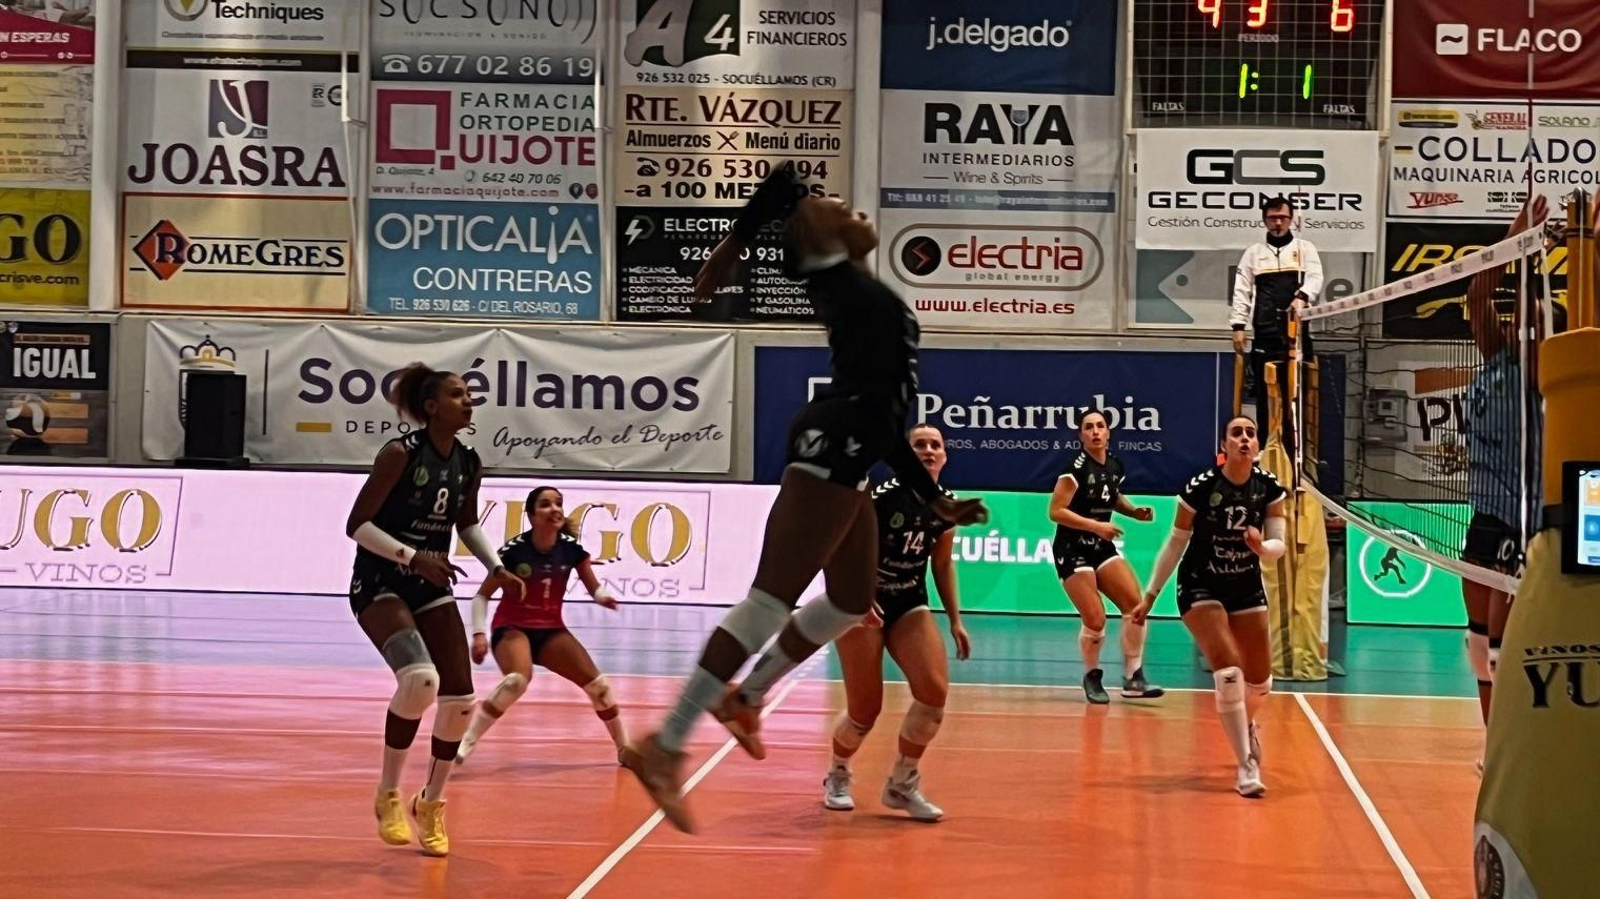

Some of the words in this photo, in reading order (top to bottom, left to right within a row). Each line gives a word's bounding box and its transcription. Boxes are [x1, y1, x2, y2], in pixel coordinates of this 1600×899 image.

[214, 1, 324, 24] Techniques
[758, 11, 836, 25] SERVICIOS
[747, 31, 848, 47] FINANCIEROS
[926, 17, 1070, 52] j.delgado
[1477, 28, 1583, 52] FLACO
[418, 55, 467, 74] 677
[476, 55, 509, 76] 02
[518, 56, 552, 77] 86
[563, 57, 594, 77] 19
[636, 73, 659, 83] 926
[663, 73, 685, 84] 532
[688, 74, 710, 84] 025
[722, 73, 807, 86] SOCUÉLLAMOS
[812, 76, 836, 87] (CR)
[460, 92, 595, 109] FARMACIA
[625, 94, 688, 122] RTE.
[698, 91, 842, 127] VÁZQUEZ
[1152, 102, 1185, 112] FALTAS
[1323, 104, 1355, 114] FALTAS
[460, 115, 595, 133] ORTOPEDIA
[924, 103, 1075, 146] RAYA
[626, 130, 711, 149] Almuerzos
[745, 132, 789, 150] Menú
[794, 133, 841, 151] diario
[1418, 136, 1597, 164] COLLADO
[128, 143, 346, 187] JOASRA
[664, 158, 712, 178] 926
[723, 160, 770, 179] 530
[923, 153, 1075, 167] INTERMEDIARIOS
[1187, 149, 1326, 185] GCS
[528, 174, 543, 184] 70
[954, 172, 986, 183] Wine
[991, 173, 1000, 184] &
[1003, 172, 1044, 186] Spirits
[1393, 167, 1514, 184] MAQUINARIA
[661, 181, 707, 198] 100
[1148, 216, 1200, 228] Gestión
[1304, 218, 1366, 230] Servicios
[680, 247, 712, 260] 926
[757, 247, 784, 261] 931
[947, 235, 1083, 271] electria
[413, 267, 593, 294] CONTRERAS
[965, 272, 1009, 282] global
[1014, 274, 1061, 284] energy
[413, 298, 430, 311] 926
[491, 301, 512, 313] DEL
[566, 303, 578, 314] 68
[667, 296, 679, 304] DE
[915, 298, 1075, 315] www.electria.es
[13, 347, 97, 379] IGUAL
[298, 357, 700, 412] Socéllamos
[915, 394, 1162, 431] Peñarrubia
[493, 425, 602, 459] Apoyando
[611, 424, 633, 445] el
[639, 424, 724, 452] Deporte
[980, 440, 1048, 450] ABOGADOS
[1053, 440, 1060, 450] &
[1118, 442, 1162, 452] FINCAS
[433, 488, 449, 514] 8
[1101, 484, 1111, 502] 4
[1224, 505, 1248, 530] 12
[902, 531, 925, 555] 14
[25, 563, 147, 583] VINOS
[541, 578, 552, 598] 1
